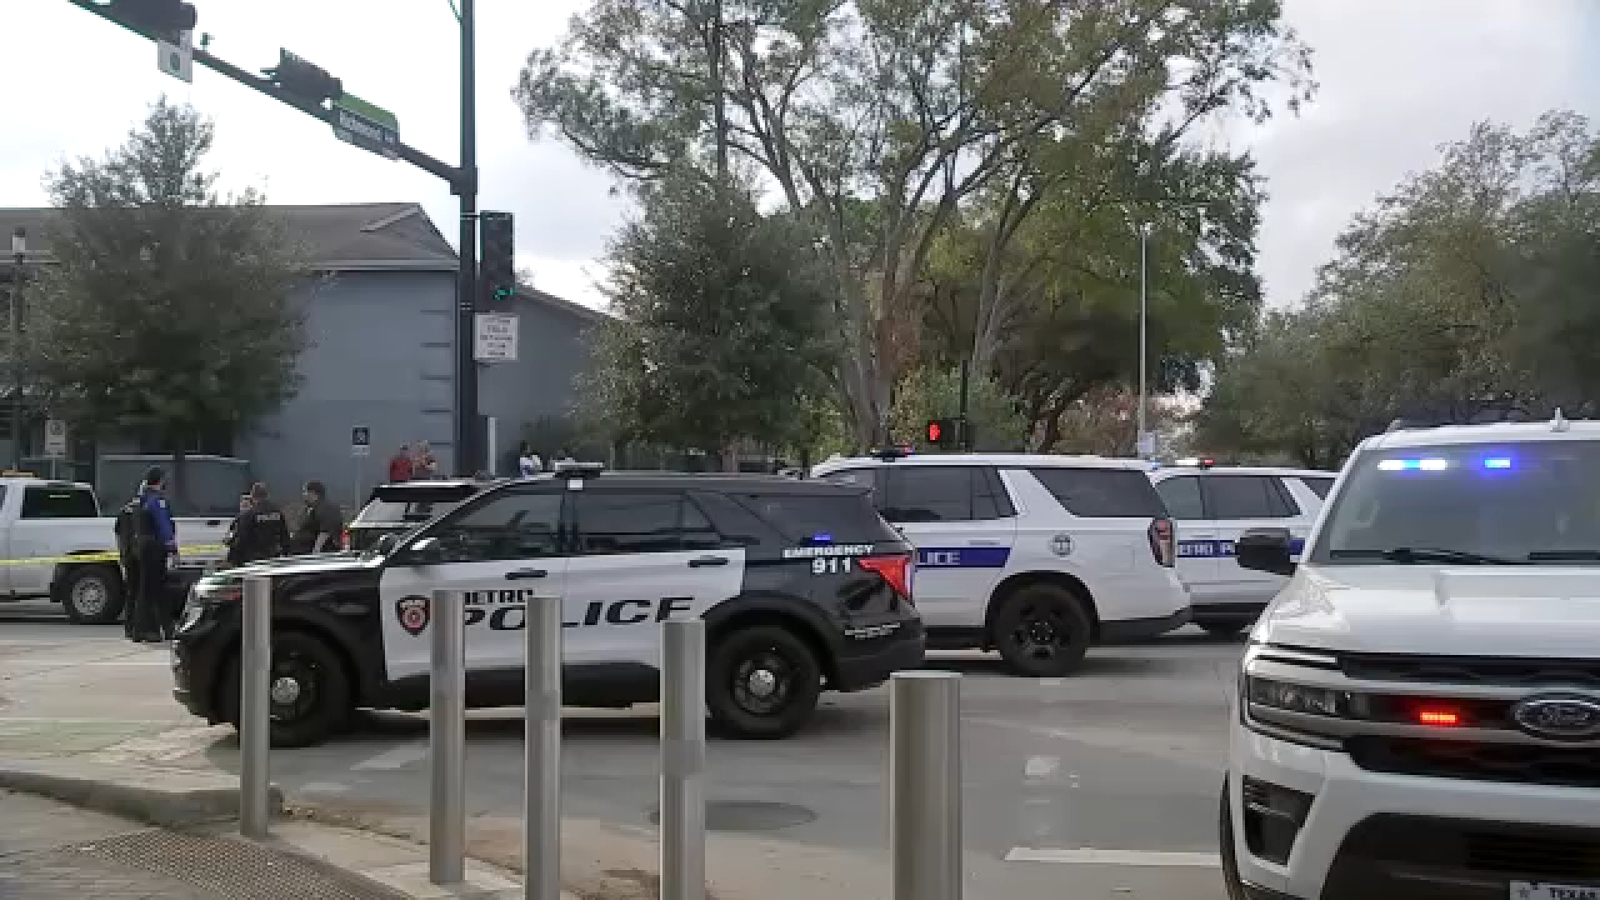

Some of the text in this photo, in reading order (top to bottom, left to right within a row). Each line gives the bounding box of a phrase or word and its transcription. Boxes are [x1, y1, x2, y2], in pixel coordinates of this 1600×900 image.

[783, 545, 873, 558] EMERGENCY
[812, 557, 850, 573] 911
[464, 596, 695, 630] POICE
